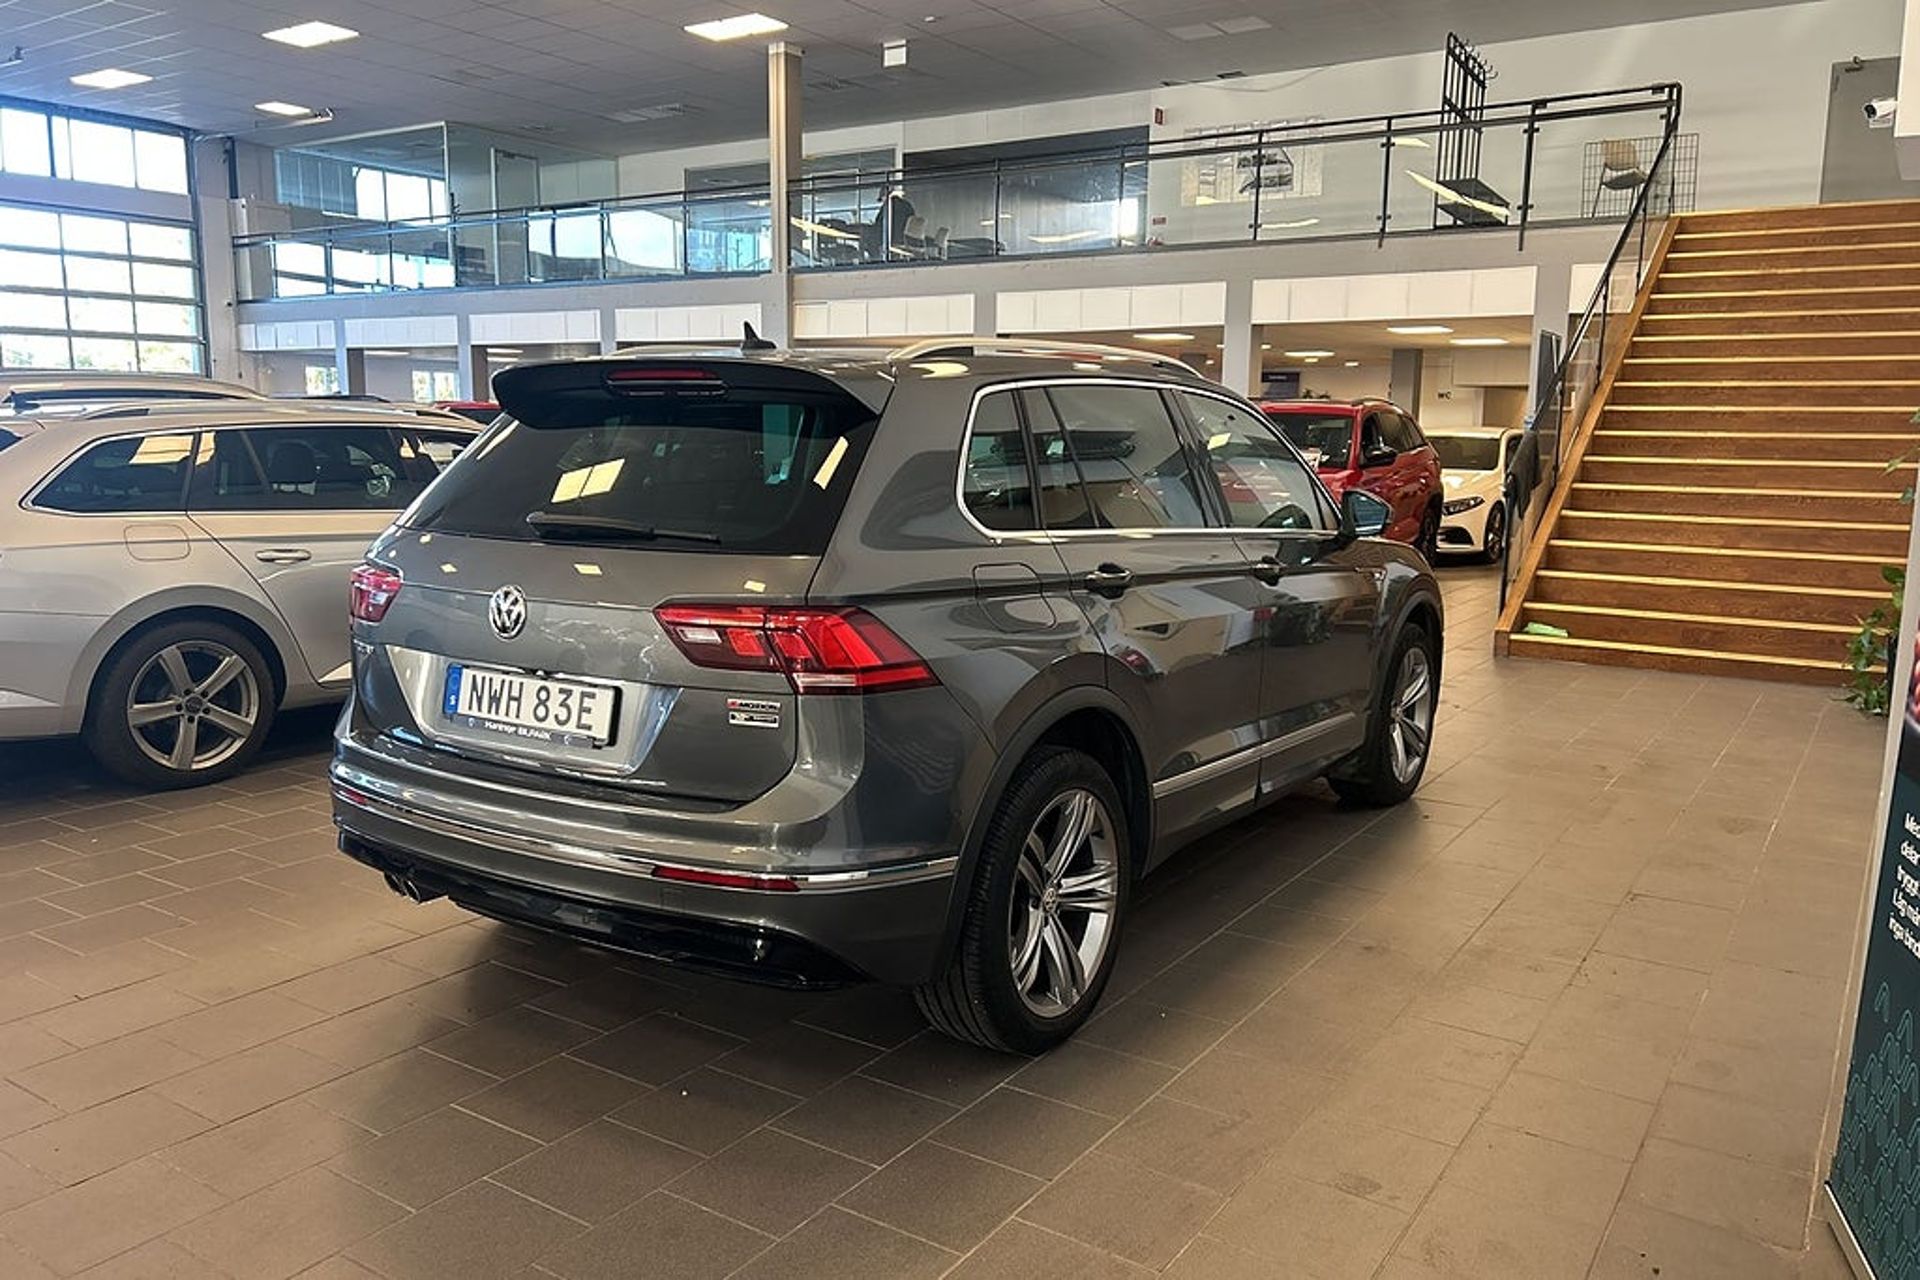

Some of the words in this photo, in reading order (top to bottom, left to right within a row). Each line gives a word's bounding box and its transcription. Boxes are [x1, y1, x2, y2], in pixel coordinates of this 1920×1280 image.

[1437, 391, 1452, 400] WC
[467, 674, 524, 719] NWH
[533, 685, 597, 731] 83E
